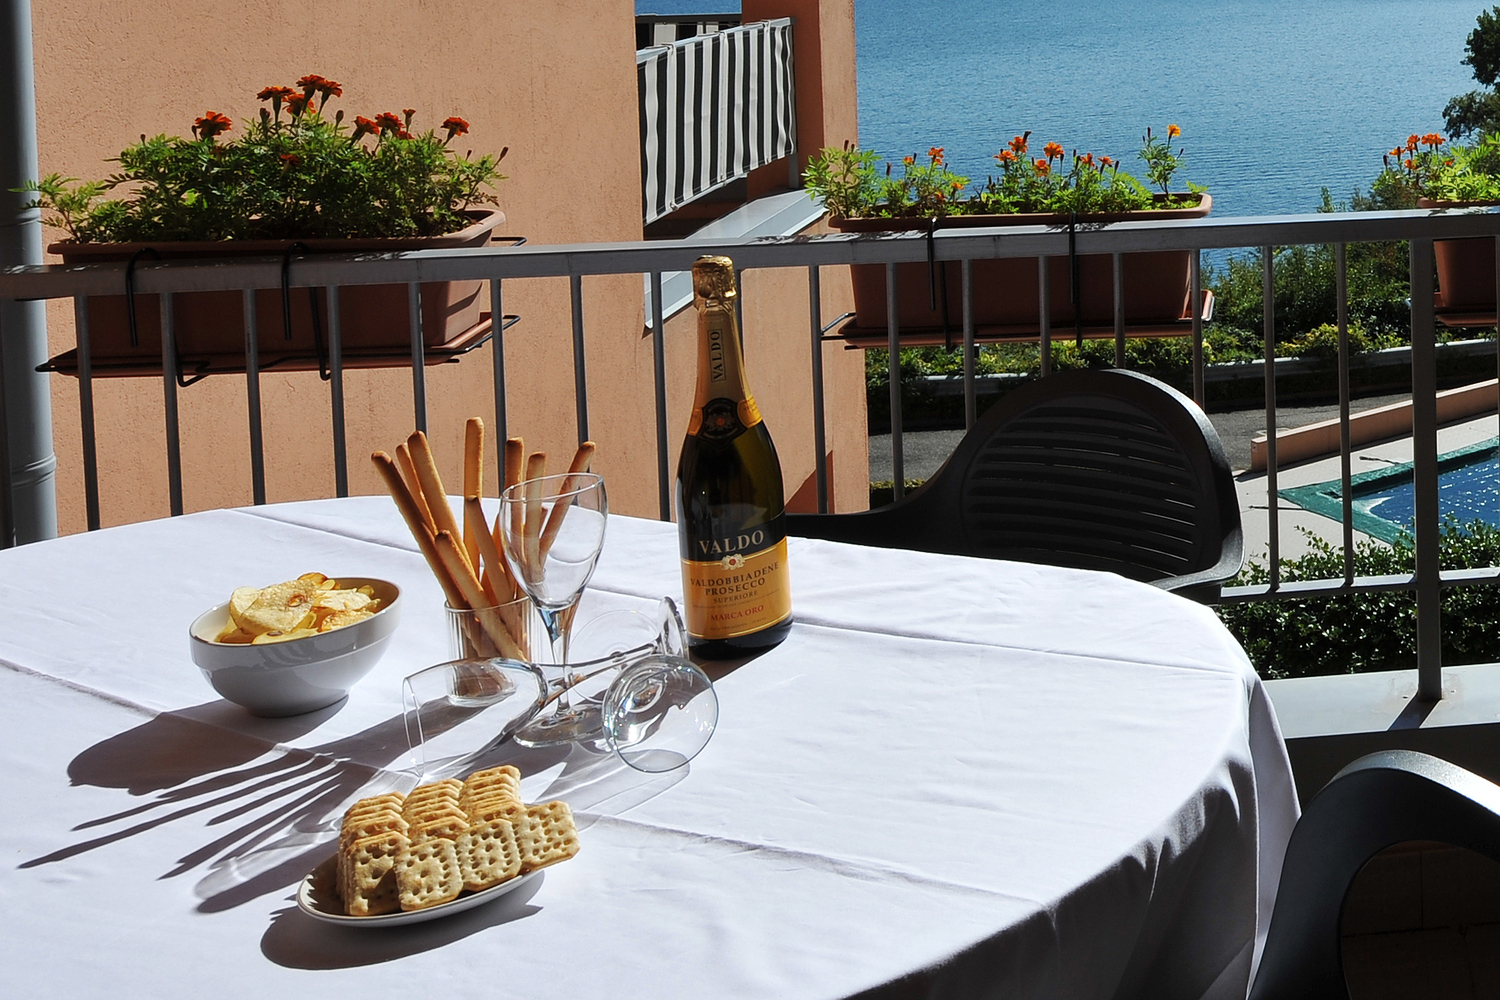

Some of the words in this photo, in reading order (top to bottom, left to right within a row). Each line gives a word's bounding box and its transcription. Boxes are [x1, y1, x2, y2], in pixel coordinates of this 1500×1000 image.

[710, 331, 723, 379] VALDO
[699, 530, 764, 554] VALDO
[690, 561, 779, 587] VALDOBBIADENE
[705, 577, 766, 596] PROSECCO
[713, 590, 758, 603] SUPERIORE
[710, 611, 743, 621] MARCA
[745, 604, 764, 615] ORO
